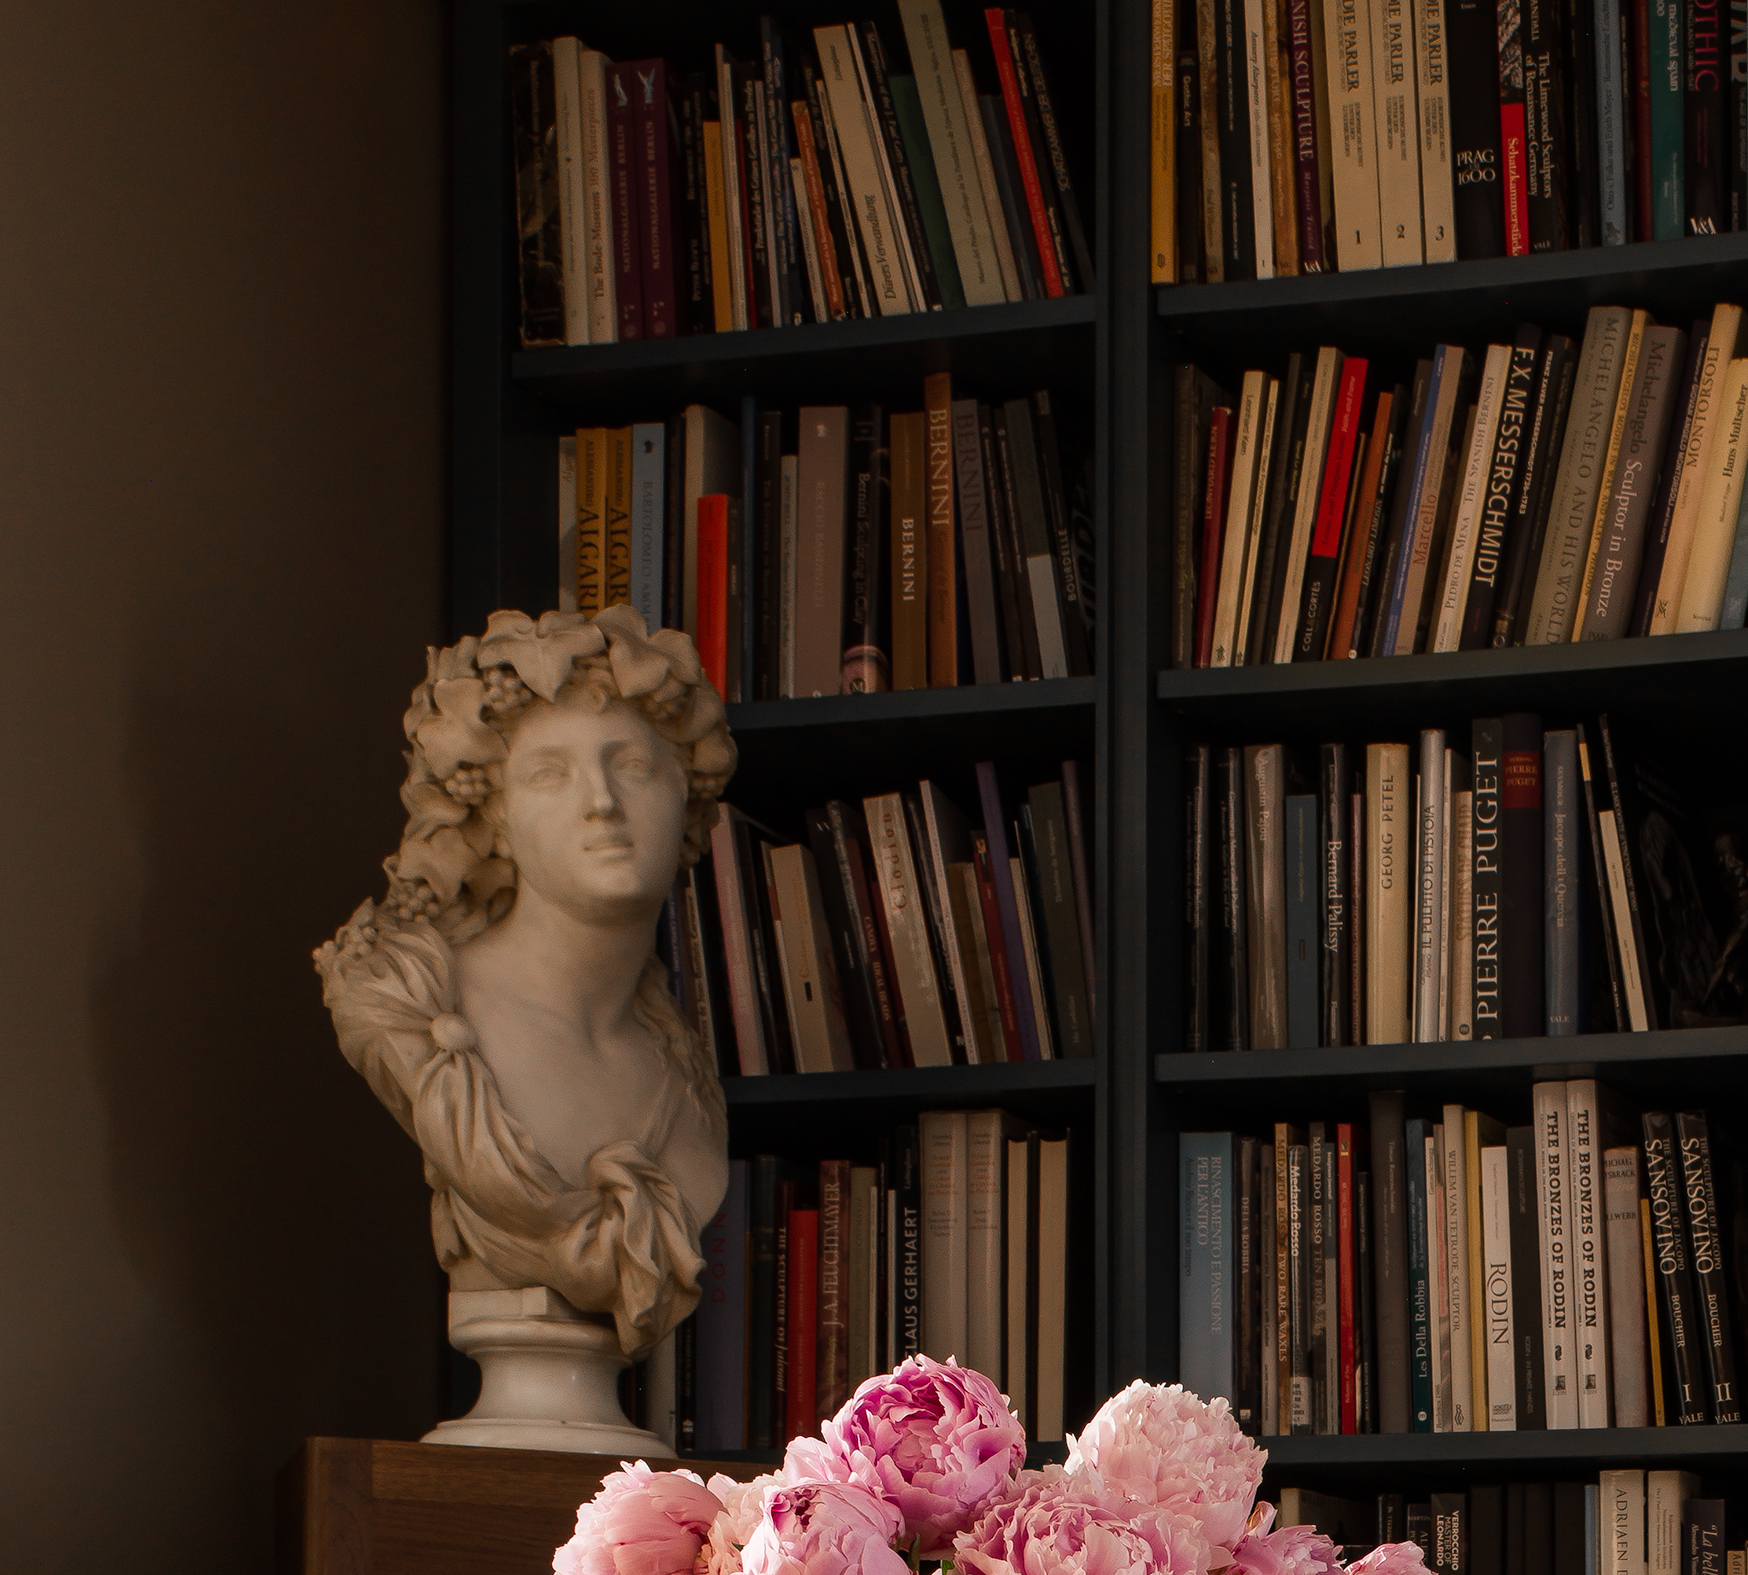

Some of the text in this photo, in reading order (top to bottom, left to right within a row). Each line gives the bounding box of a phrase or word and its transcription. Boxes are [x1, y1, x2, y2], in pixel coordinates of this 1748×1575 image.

[1288, 0, 1315, 161] NISH SCULPTURE
[1343, 30, 1360, 92] PARLER
[1456, 149, 1495, 166] PRAG
[1458, 167, 1496, 186] 1600
[1525, 54, 1539, 197] of Renaissance Germany
[1537, 52, 1556, 199] The Limewood Sculptors
[616, 123, 630, 272] NATIONALGALERIE BERLIN
[862, 194, 896, 300] Dürers Verwandlung
[1685, 342, 1720, 467] MONTORSOLI
[929, 409, 949, 525] BERNINI
[956, 414, 983, 531] BERNINI
[1473, 346, 1535, 588] F. X. MESSERSCHMIDT
[1594, 340, 1667, 618] Michelangelo Sculptor in Bronze
[901, 518, 914, 601] BERNINI
[1057, 527, 1077, 601] BOURDELLE
[1412, 494, 1437, 565] Marcello
[882, 813, 908, 909] Clodion
[1381, 774, 1393, 889] GEORG PETEL
[1325, 840, 1343, 952] Bernard Palissy
[1475, 750, 1497, 1020] PIERRE PUGET
[821, 1178, 842, 1294] FEUCHTMAYER
[903, 1206, 918, 1300] GERHAERT
[1546, 1111, 1565, 1328] THE BRONZES OF RODIN
[1643, 1138, 1677, 1274] SANSOVINO
[1680, 1138, 1714, 1274] SANSOVINO
[822, 1315, 844, 1327] J.
[1488, 1262, 1509, 1344] RODIN
[1670, 1294, 1685, 1347] BOUCHER
[1706, 1293, 1722, 1346] BOUCHER
[1436, 1514, 1444, 1567] LEONARDO
[1444, 1552, 1451, 1564] OF
[1451, 1510, 1459, 1571] VERROCCHIO
[1615, 1488, 1627, 1561] ADRIAEN
